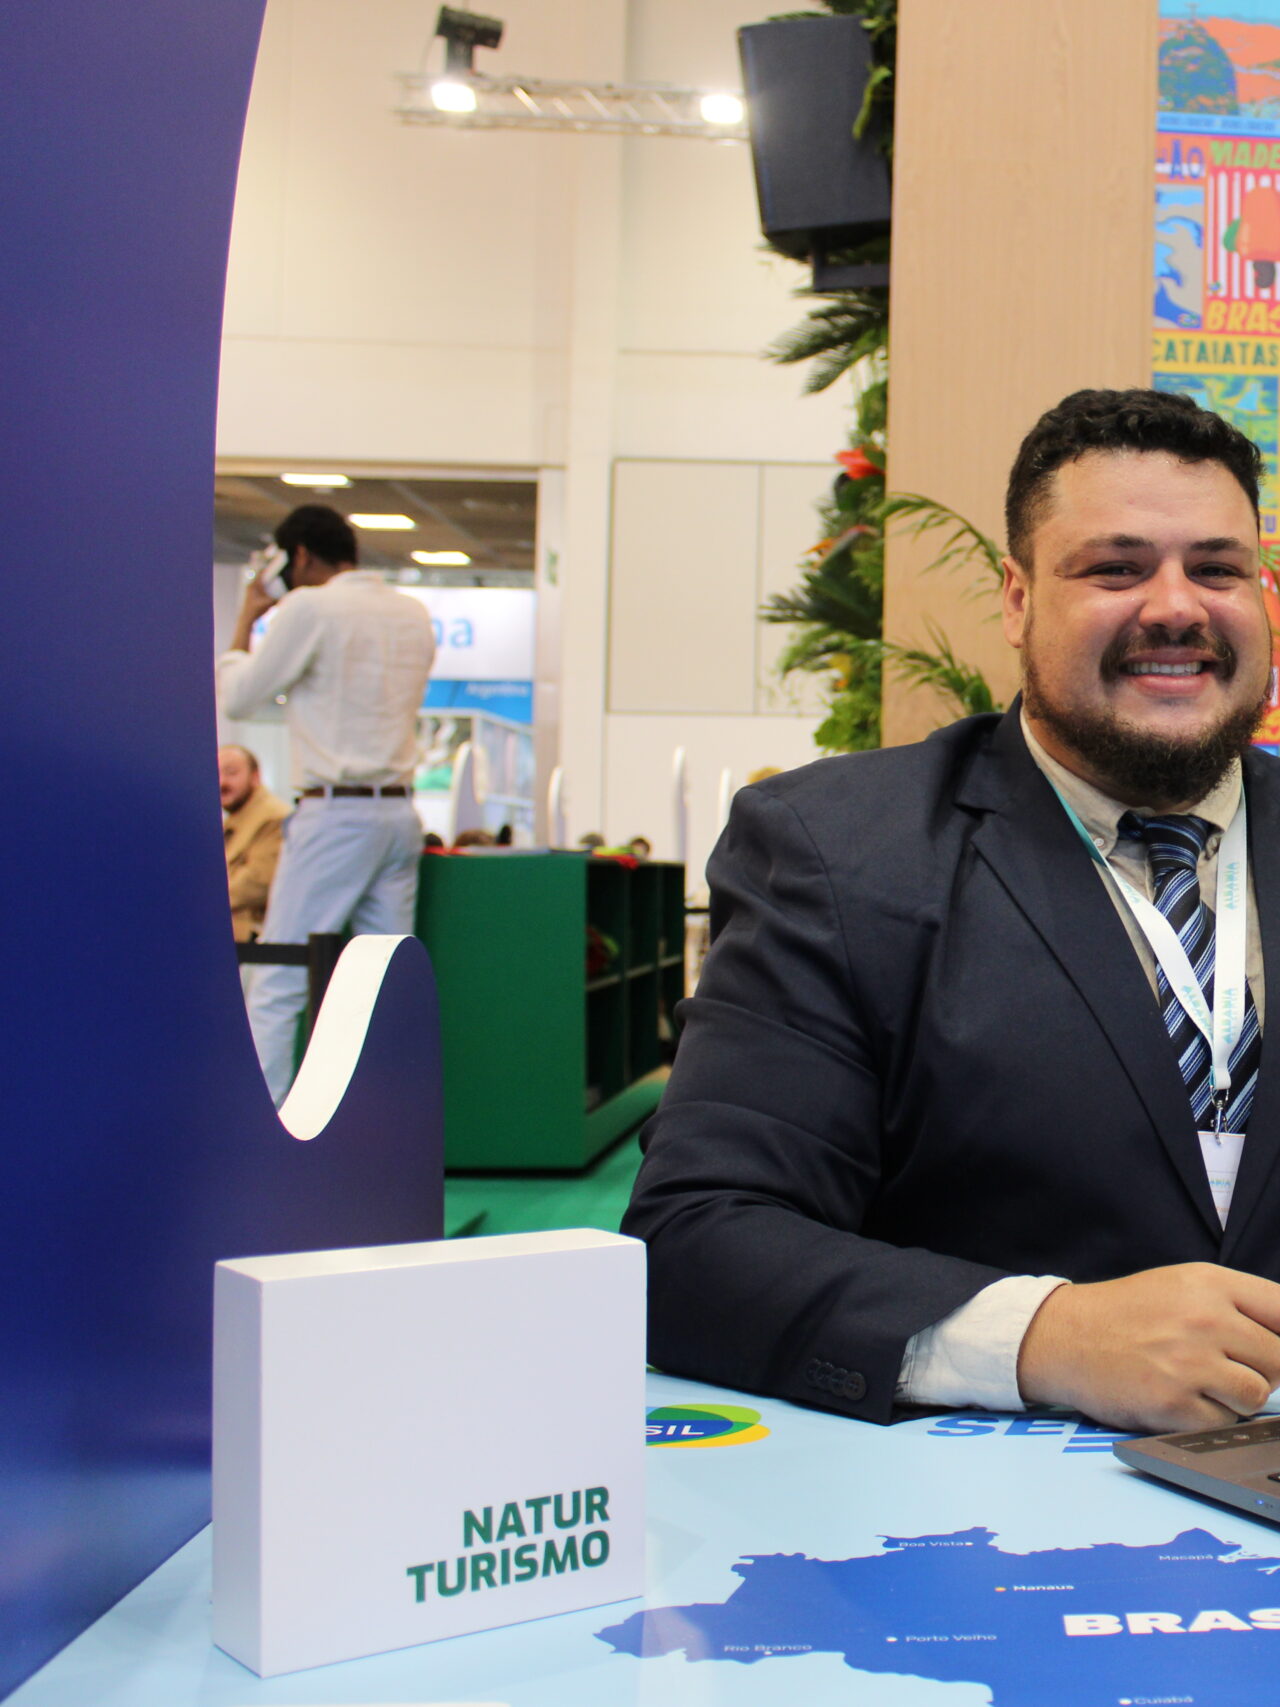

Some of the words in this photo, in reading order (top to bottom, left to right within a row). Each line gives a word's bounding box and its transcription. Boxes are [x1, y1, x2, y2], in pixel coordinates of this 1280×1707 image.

[463, 1486, 610, 1548] NATUR
[407, 1530, 610, 1603] TURISMO
[1012, 1584, 1075, 1592] Manaus
[905, 1634, 948, 1643] Porto
[952, 1633, 998, 1642] Velho
